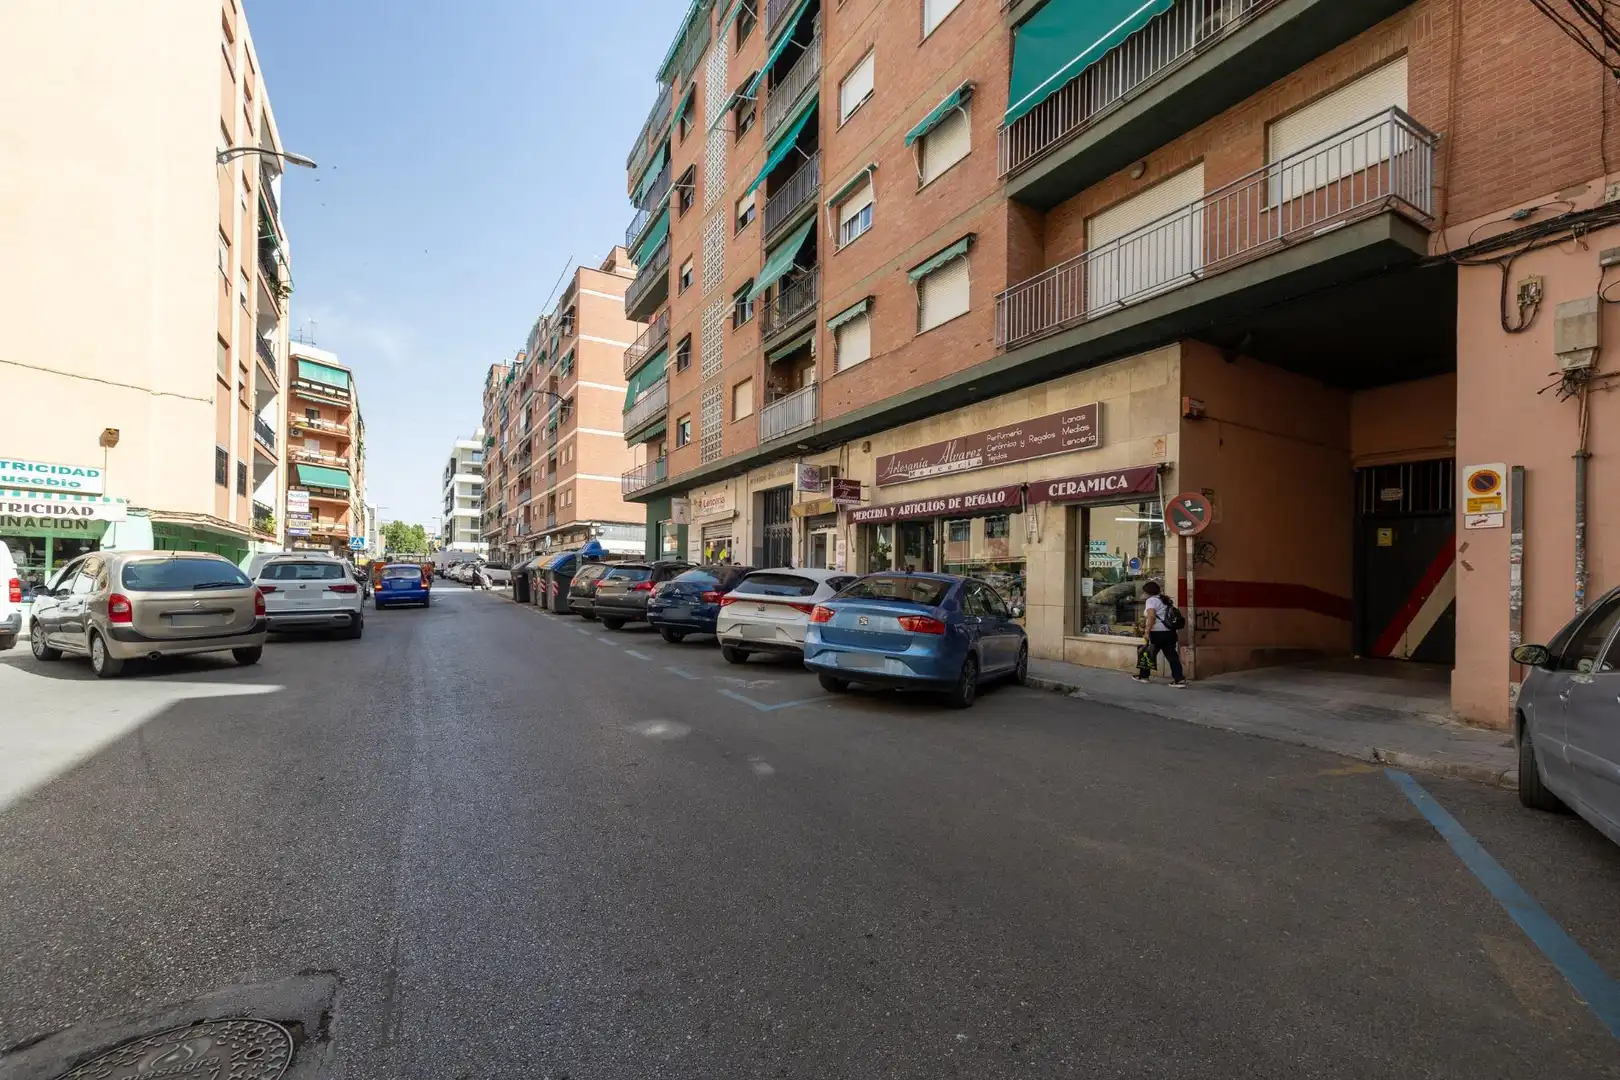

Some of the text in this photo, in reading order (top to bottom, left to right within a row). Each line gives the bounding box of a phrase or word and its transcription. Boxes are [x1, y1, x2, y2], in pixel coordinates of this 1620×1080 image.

[1061, 414, 1086, 425] Lanas
[1061, 424, 1090, 436] Medias
[1020, 439, 1025, 448] y
[1028, 431, 1056, 444] Regalos
[1061, 432, 1096, 447] Lencería
[987, 452, 1008, 463] Tejidos
[1048, 475, 1128, 496] CERAMICA
[852, 490, 1006, 521] MERCERIA Y ARTICULOS DE REGALO
